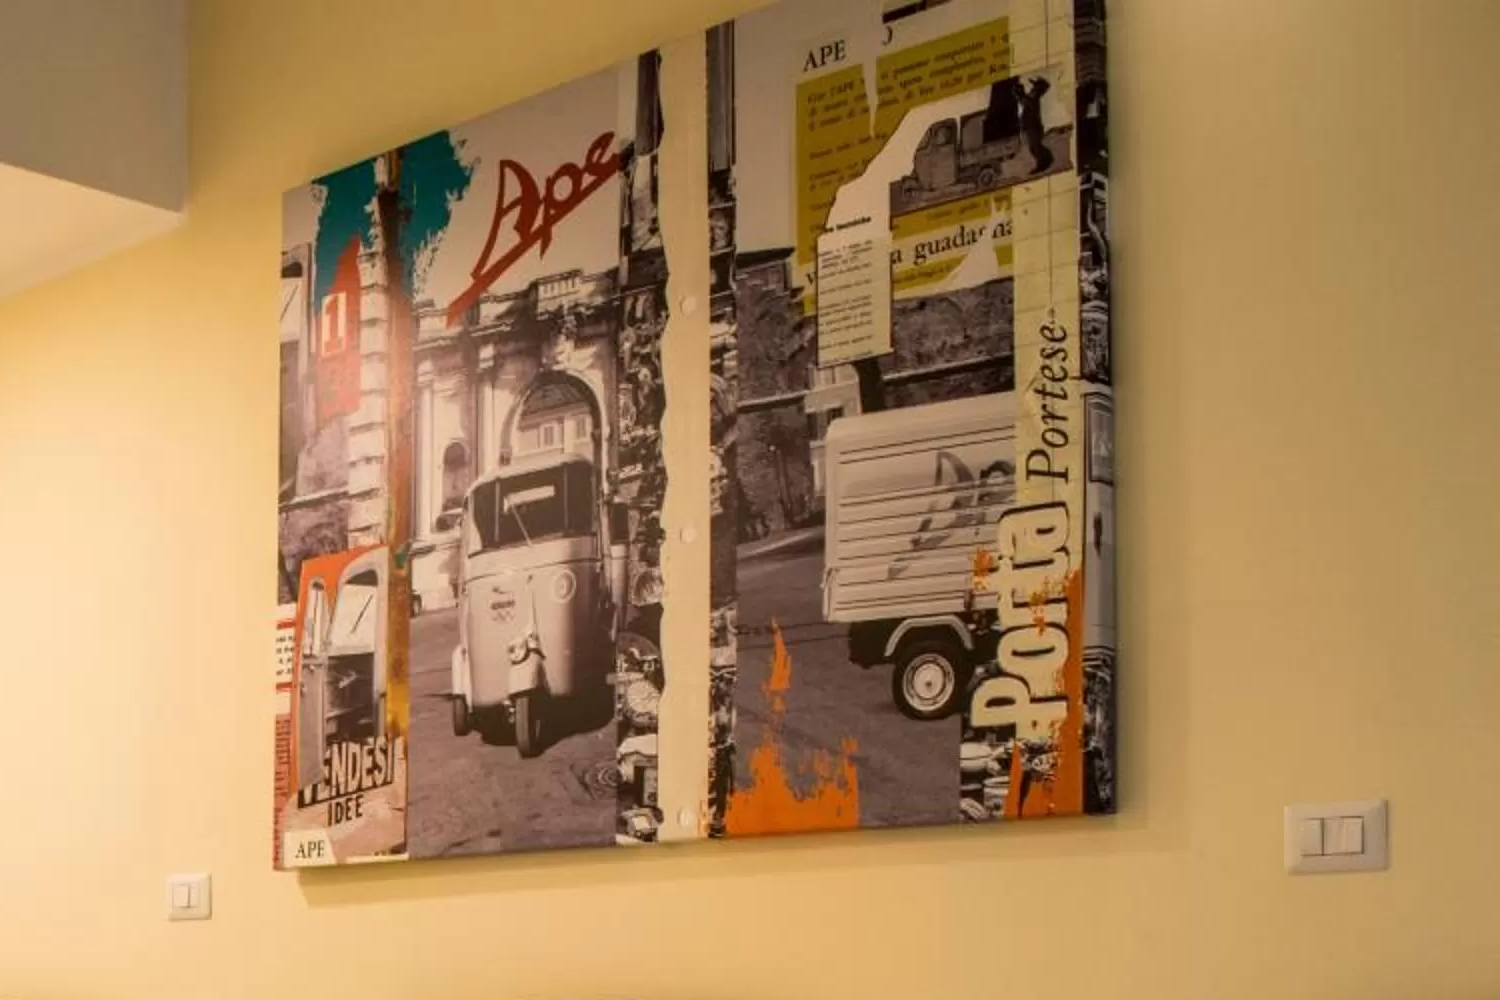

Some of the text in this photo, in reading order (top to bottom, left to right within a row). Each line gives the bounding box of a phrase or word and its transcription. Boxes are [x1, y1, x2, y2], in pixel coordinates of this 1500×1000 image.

[803, 39, 846, 72] APE
[447, 131, 620, 329] Ape
[970, 325, 1070, 740] Porta Portese
[328, 794, 364, 826] IDEE
